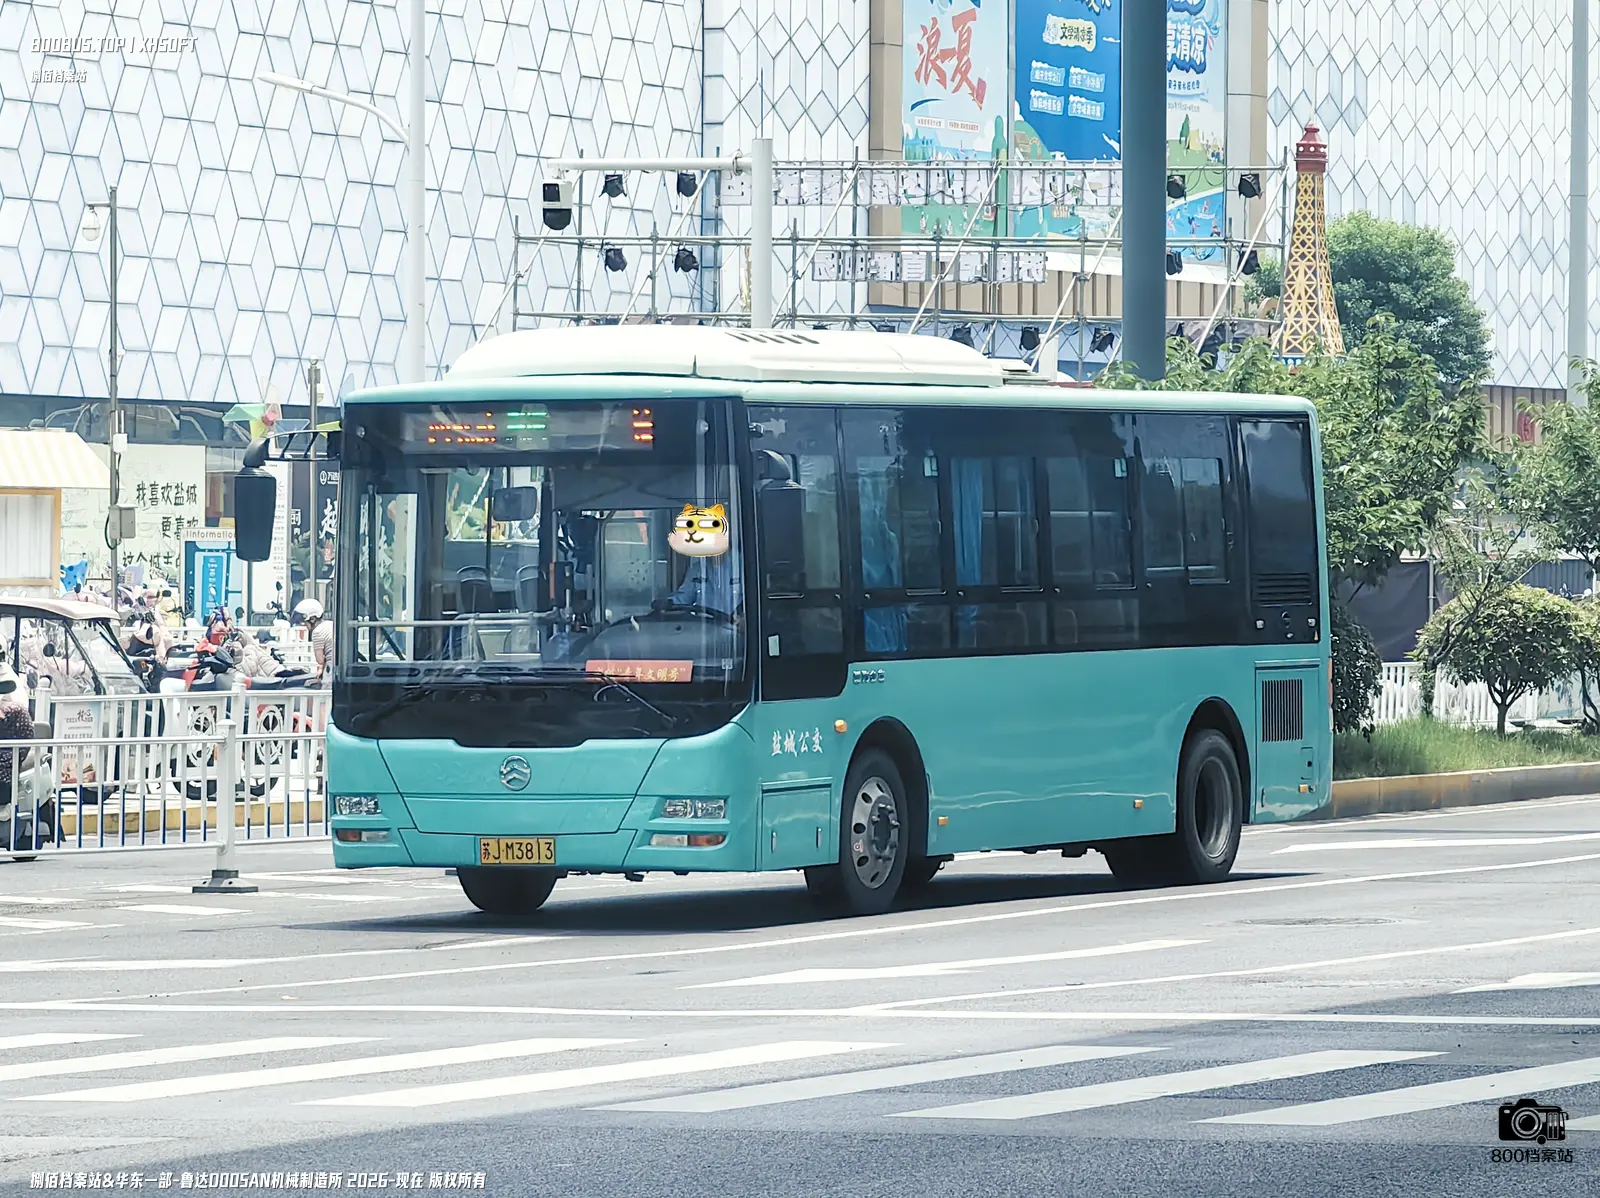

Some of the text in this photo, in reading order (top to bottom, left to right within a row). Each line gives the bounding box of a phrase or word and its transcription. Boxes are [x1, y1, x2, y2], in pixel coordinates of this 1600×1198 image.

[136, 480, 198, 507] 我喜欢盐城
[771, 727, 823, 757] 盐城公交
